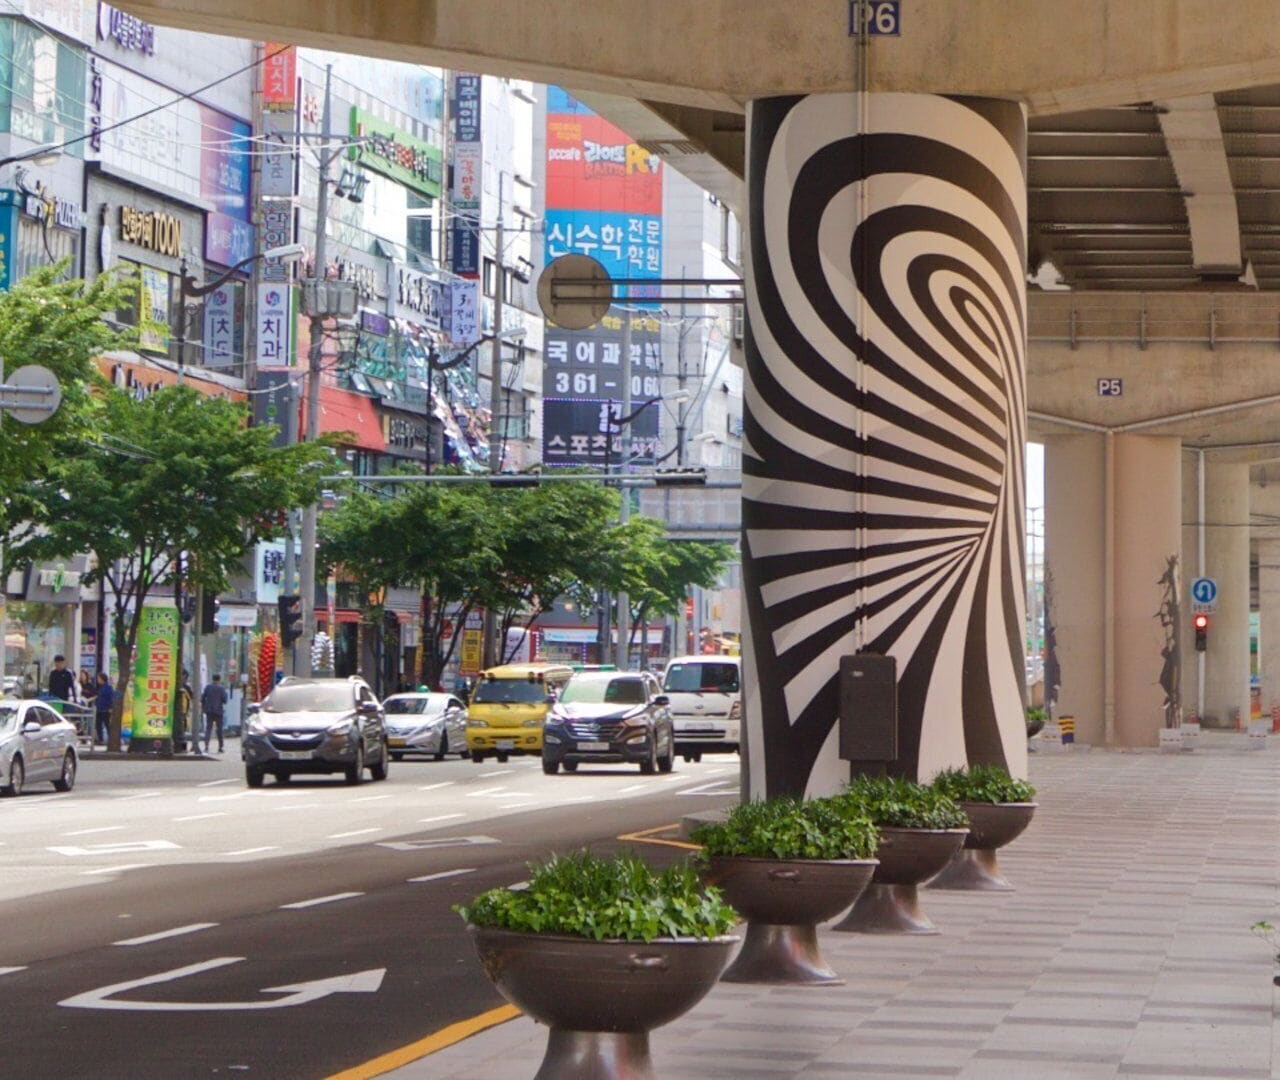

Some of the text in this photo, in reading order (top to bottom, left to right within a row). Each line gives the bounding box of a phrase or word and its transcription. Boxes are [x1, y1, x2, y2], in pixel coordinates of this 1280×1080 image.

[547, 218, 661, 272] 신수학 전문 학원
[262, 318, 282, 360] 치과
[1098, 378, 1122, 396] P5
[146, 639, 171, 717] 스포츠마사지
